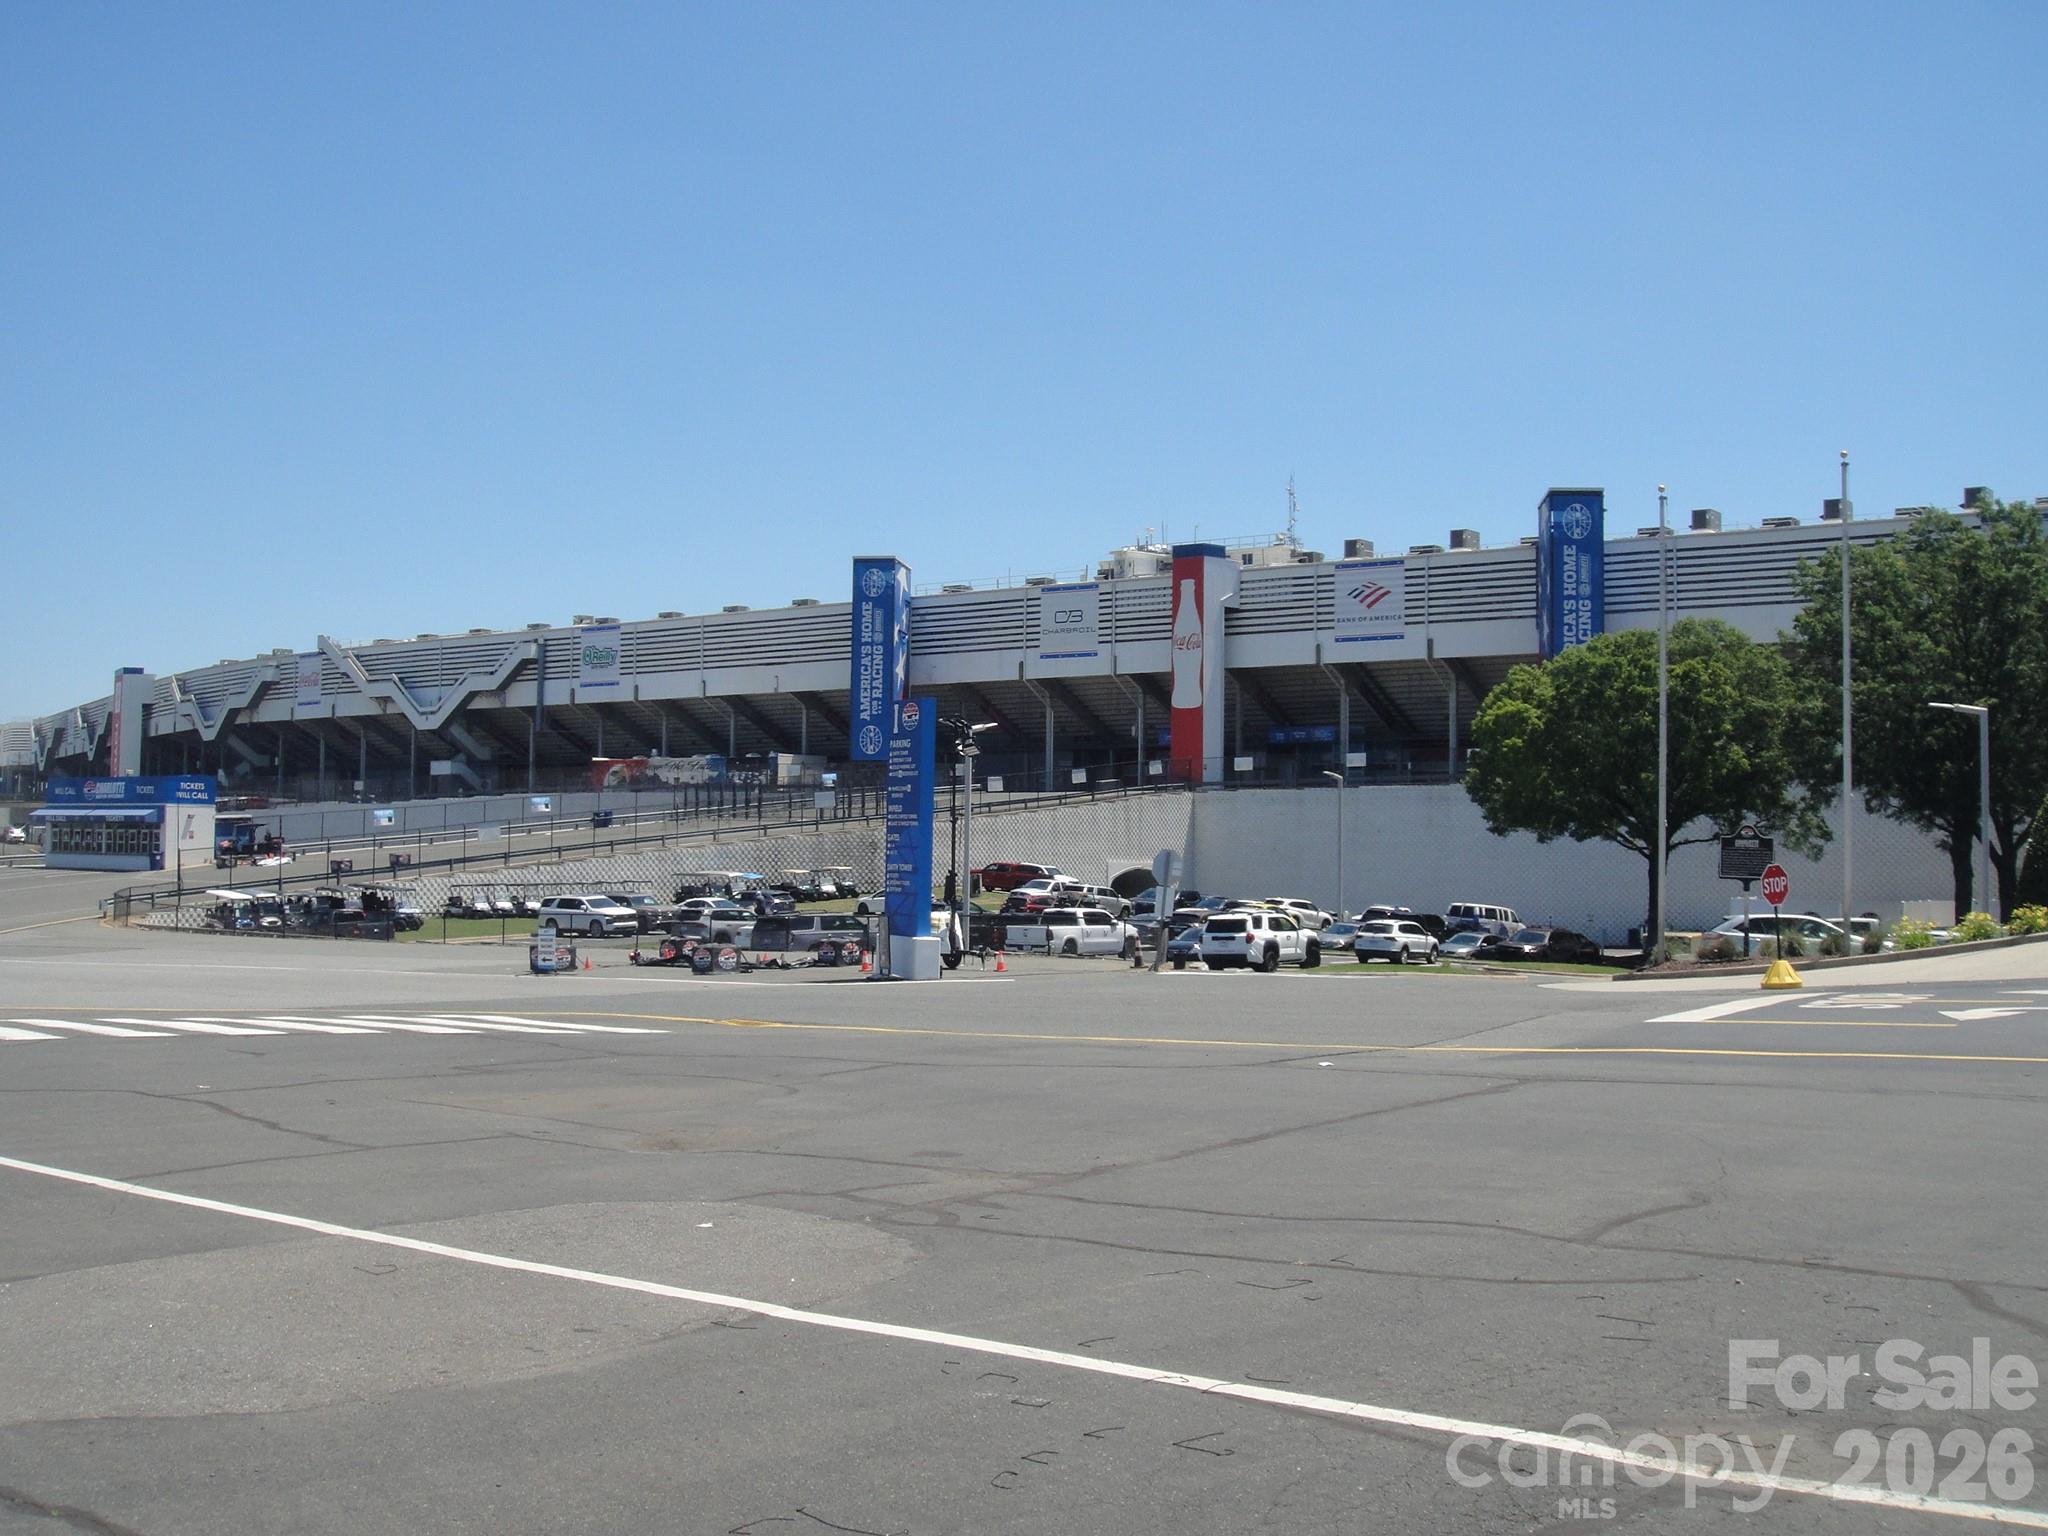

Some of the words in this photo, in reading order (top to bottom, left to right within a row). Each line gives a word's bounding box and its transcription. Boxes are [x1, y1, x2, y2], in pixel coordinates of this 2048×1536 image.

[1563, 544, 1577, 596] HOME
[861, 601, 873, 643] HOME
[1336, 616, 1356, 624] BANK
[1368, 614, 1403, 622] AMERICA
[1563, 600, 1577, 649] RICA'S
[1578, 599, 1592, 641] CING
[1042, 626, 1097, 636] CHARBROIL
[872, 645, 884, 698] RACING
[859, 645, 873, 721] AMERICA'S
[889, 739, 912, 748] PARKING
[136, 785, 155, 795] TICKETS
[180, 782, 205, 790] TICKETS
[176, 791, 190, 799] WILL
[191, 791, 209, 800] CALL
[1763, 876, 1787, 894] STOP
